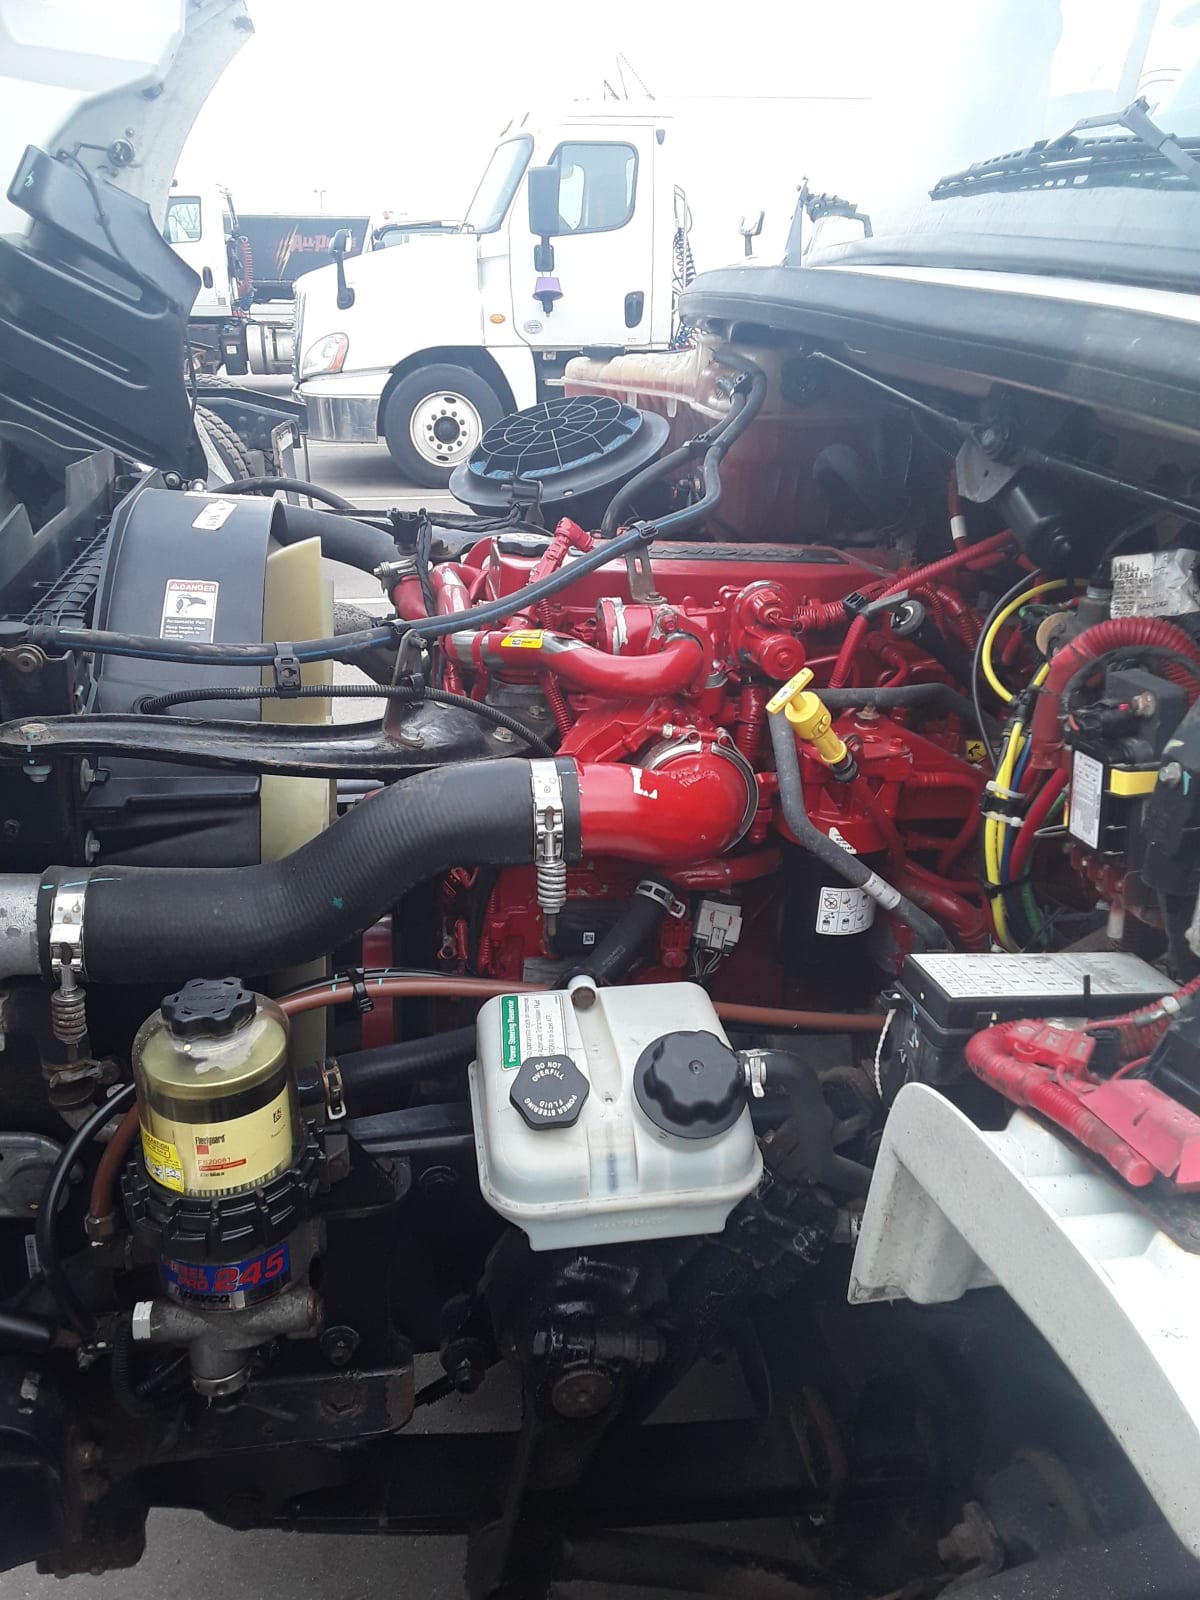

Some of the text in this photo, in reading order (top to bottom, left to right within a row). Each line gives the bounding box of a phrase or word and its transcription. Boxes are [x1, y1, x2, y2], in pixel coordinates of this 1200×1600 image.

[180, 583, 215, 592] DANGER
[507, 1000, 517, 1063] Power Steering Reservoir
[535, 1061, 562, 1070] DO NOT
[531, 1069, 565, 1082] OVERFILL
[524, 1094, 577, 1117] POWER STEERING
[539, 1098, 564, 1108] FLUID
[214, 1248, 284, 1292] 245
